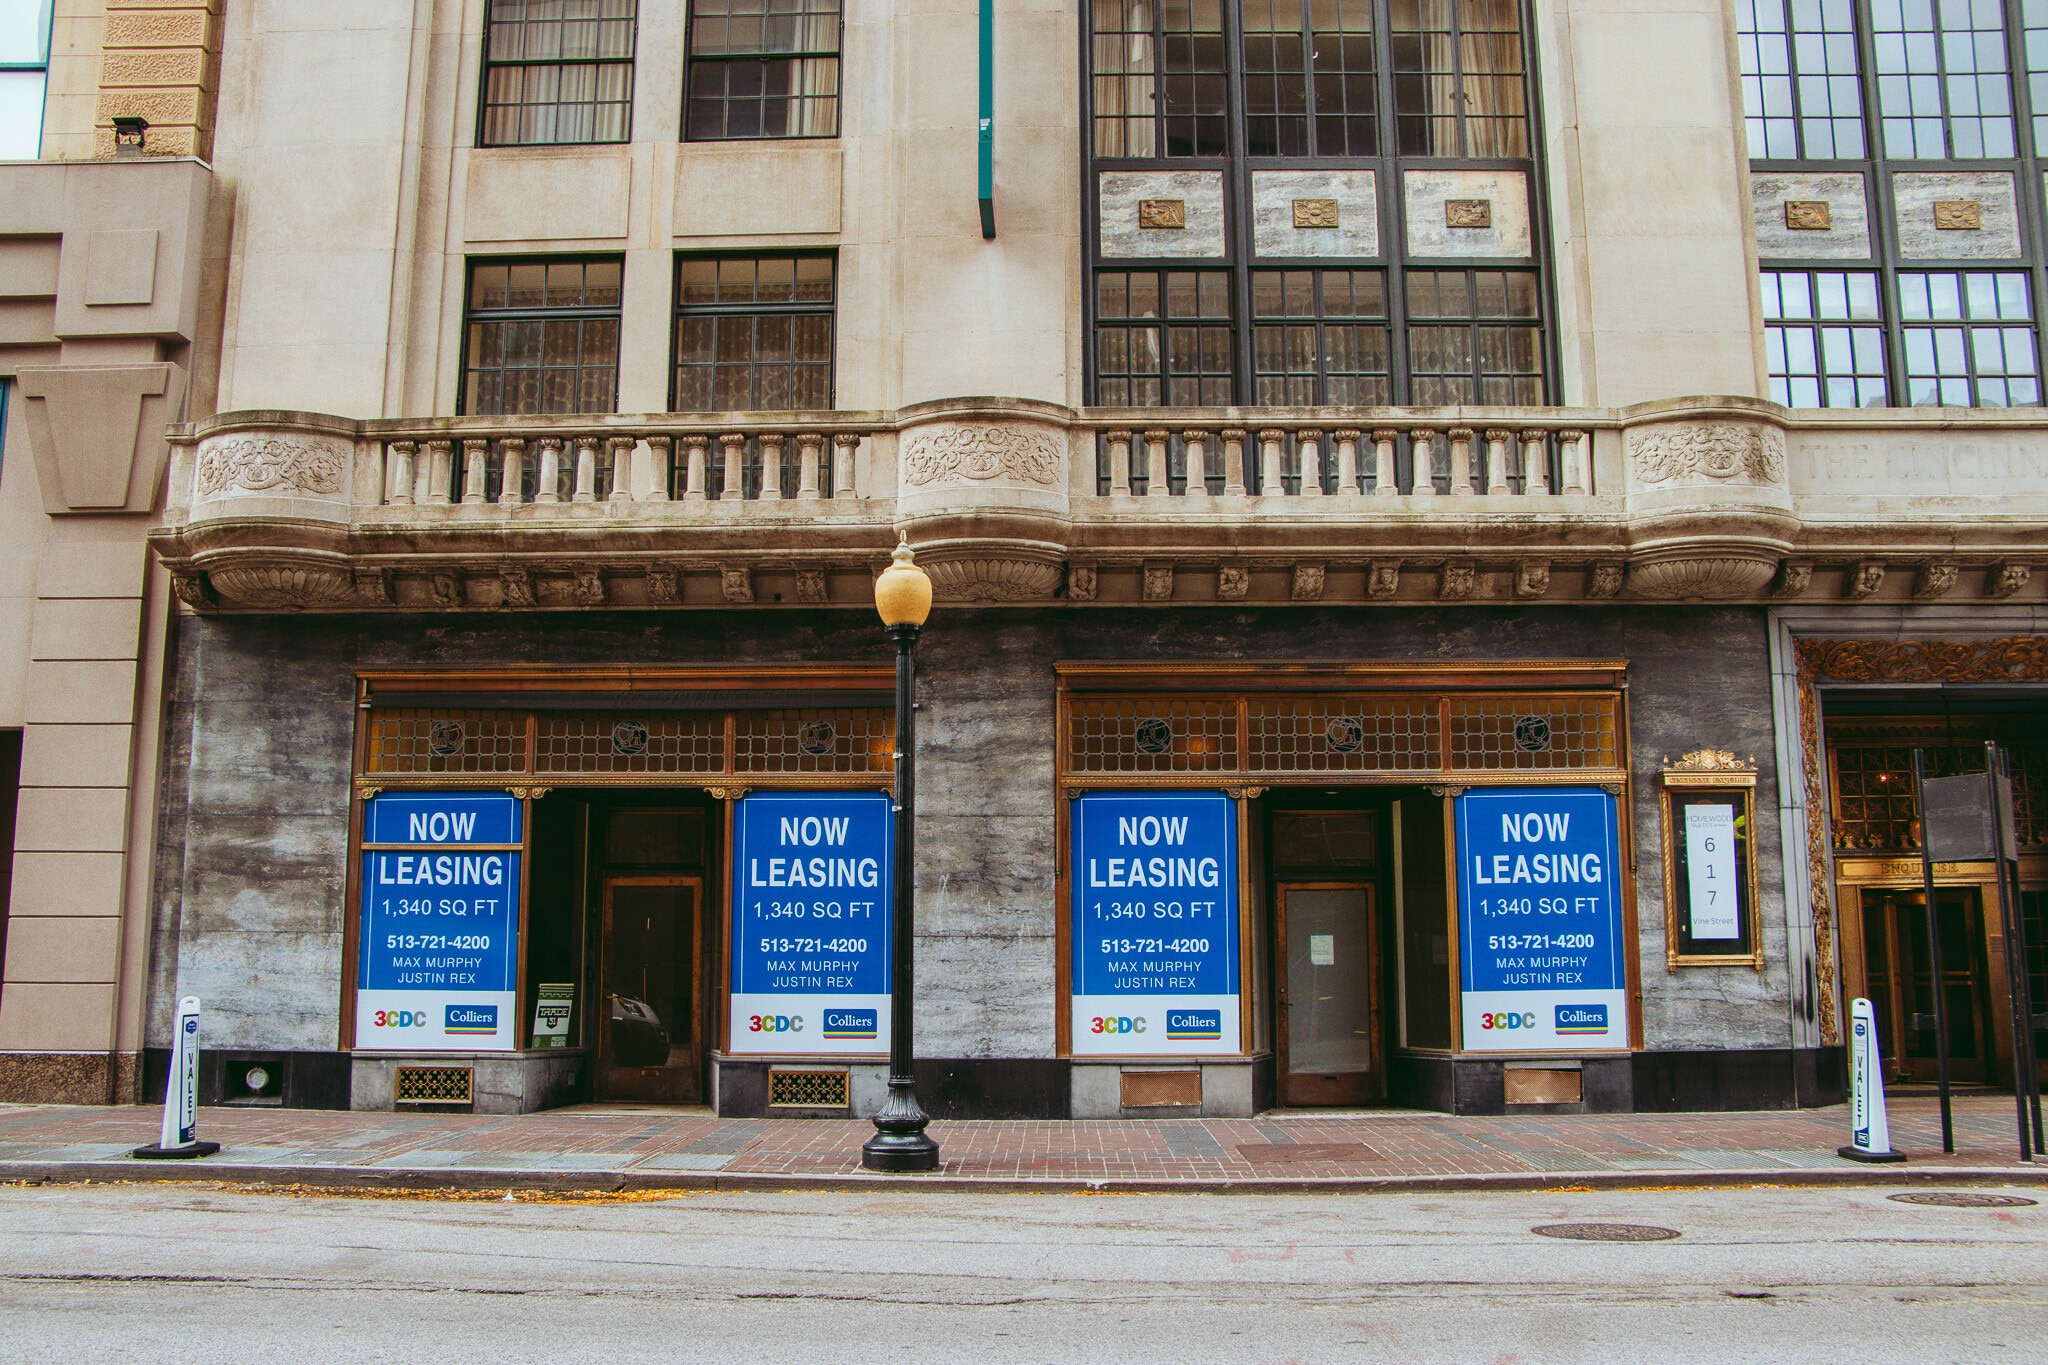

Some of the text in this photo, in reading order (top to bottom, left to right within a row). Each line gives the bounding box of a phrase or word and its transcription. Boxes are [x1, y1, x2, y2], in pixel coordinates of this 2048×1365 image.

[409, 811, 476, 841] NOW
[1686, 815, 1732, 823] HOMEWOOD
[780, 816, 849, 846] NOW
[1119, 815, 1188, 846] NOW
[1502, 812, 1569, 842] NOW
[379, 855, 501, 885] LEASING
[751, 857, 877, 887] LEASING
[1090, 857, 1218, 887] LEASING
[1475, 853, 1601, 884] LEASING
[382, 898, 498, 917] 1,340 SQ FT
[753, 901, 874, 920] 1,340 SQ FT
[1093, 901, 1215, 921] 1,340 SQ FT
[1480, 897, 1599, 917] 1,340 SQ FT
[1693, 917, 1734, 925] Vine Street
[386, 934, 489, 949] 513-721-4200
[760, 938, 867, 952] 513-721-4200
[1101, 938, 1209, 953] 513-721-4200
[1489, 933, 1594, 949] 513-721-4200
[392, 956, 481, 968] MAX MURPHY
[767, 960, 859, 971] MAX MURPHY
[1108, 961, 1201, 972] MAX MURPHY
[1496, 956, 1587, 968] MAX MURPHY
[397, 972, 476, 983] JUSTIN REX
[772, 976, 853, 987] JUSTIN REX
[1114, 977, 1196, 988] JUSTIN REX
[1502, 972, 1583, 984] JUSTIN REX
[373, 1011, 426, 1027] 3CDC
[449, 1010, 493, 1022] Colliers
[540, 1007, 568, 1016] TRADE
[1559, 1010, 1603, 1022] Colliers
[548, 1017, 556, 1026] 31
[748, 1015, 803, 1032] 3CDC
[827, 1014, 873, 1026] Colliers
[1090, 1017, 1146, 1034] 3CDC
[1171, 1015, 1216, 1027] Colliers
[1481, 1011, 1535, 1029] 3CDC
